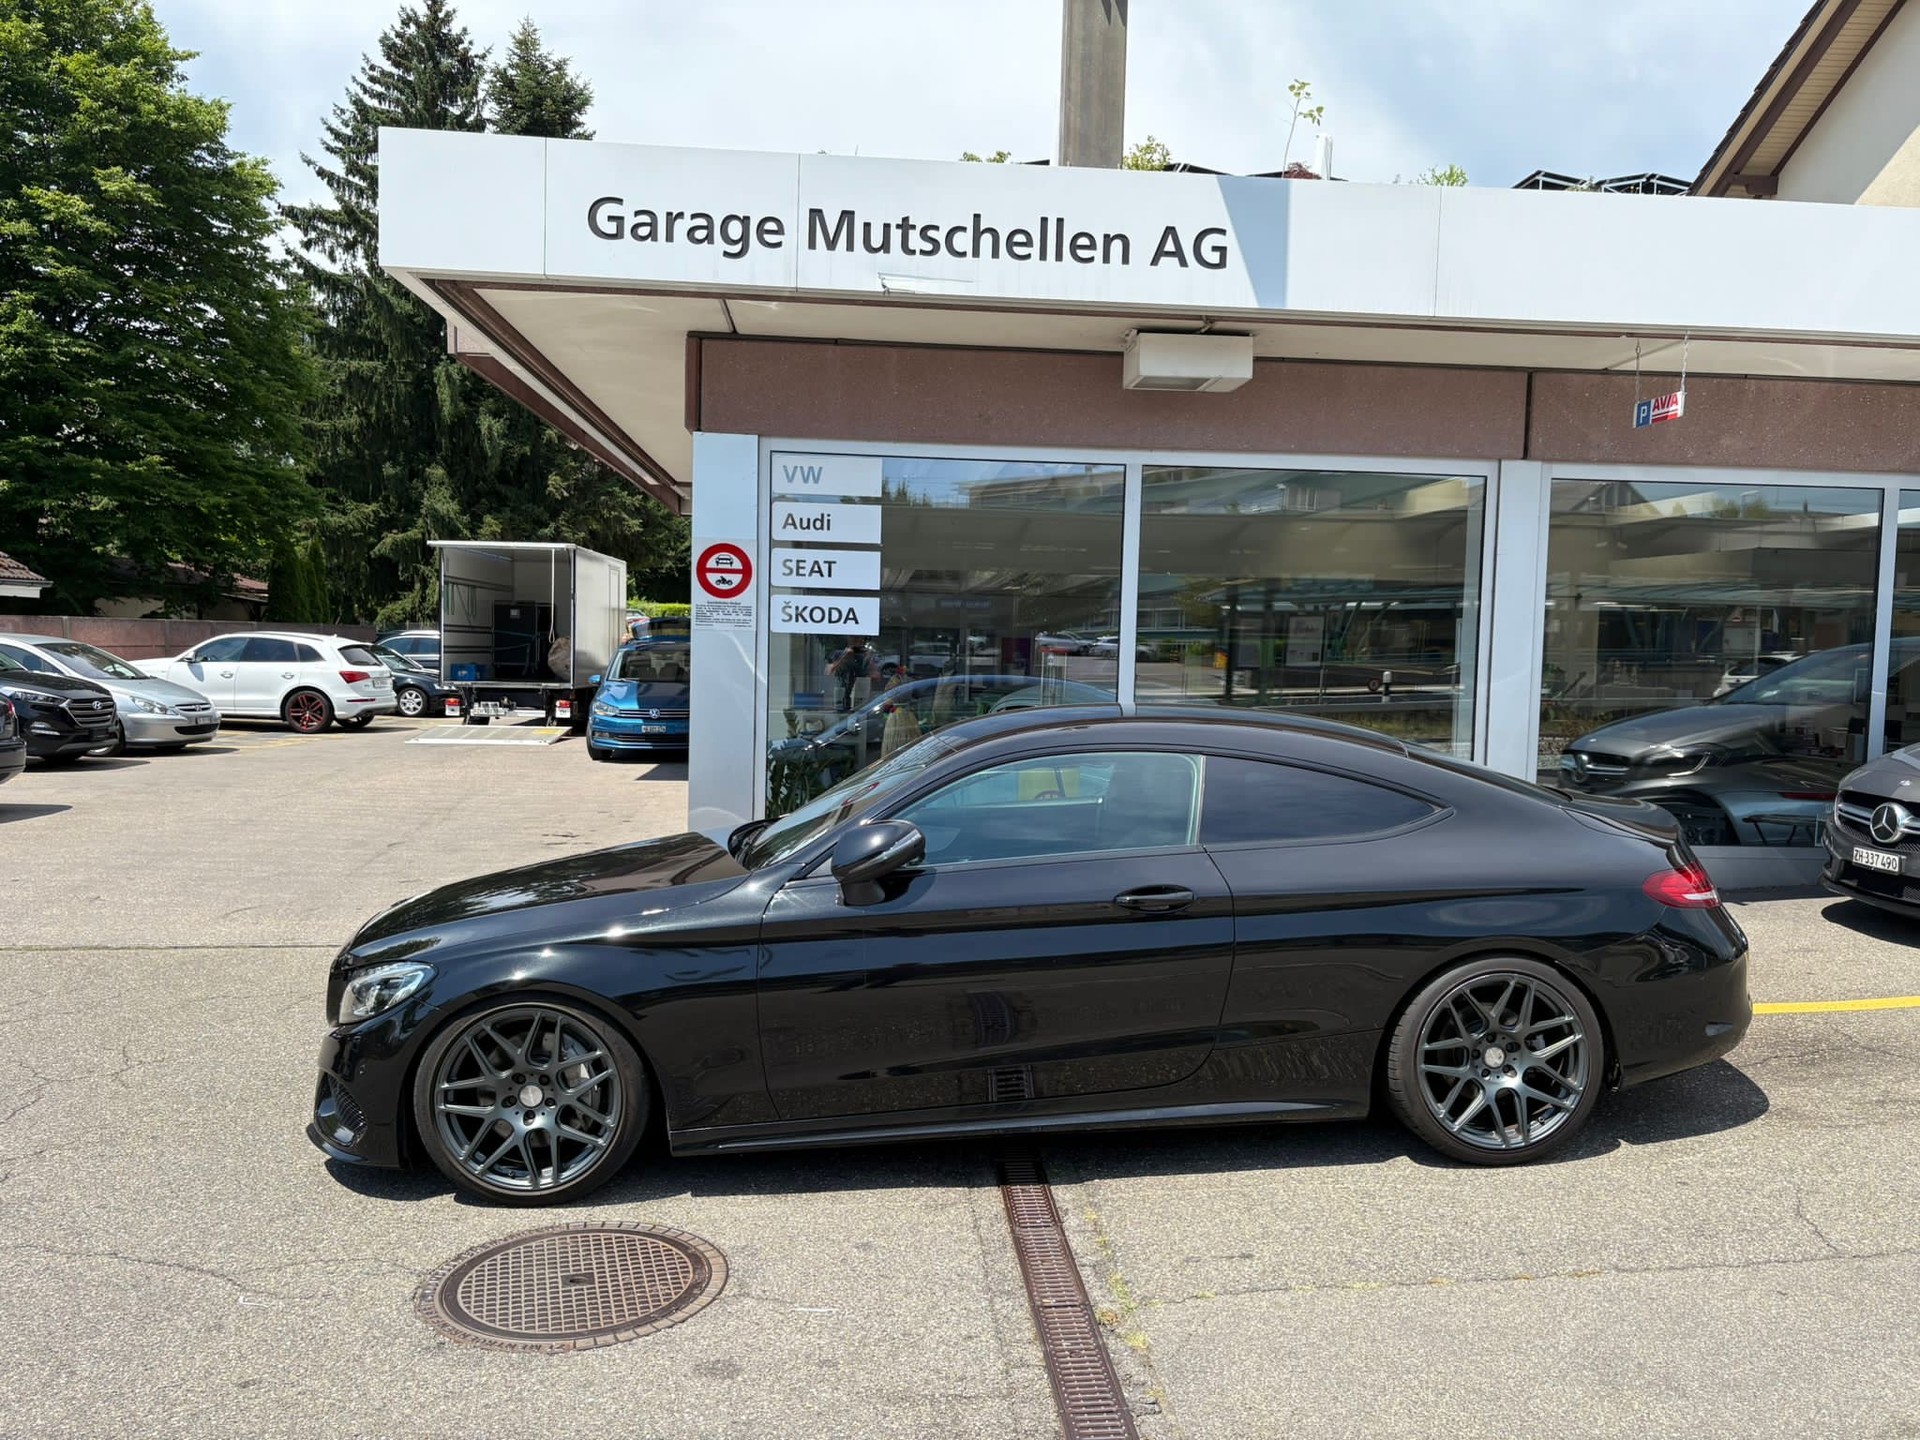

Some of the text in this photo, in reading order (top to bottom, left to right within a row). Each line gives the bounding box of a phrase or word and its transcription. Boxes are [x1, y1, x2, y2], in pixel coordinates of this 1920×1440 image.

[587, 196, 1229, 270] Garage Mutschellen AG
[1639, 394, 1679, 424] P AVIA
[782, 464, 824, 485] VW
[781, 512, 832, 532] Audi
[782, 558, 838, 579] SEAT
[781, 600, 860, 625] ŠKODA
